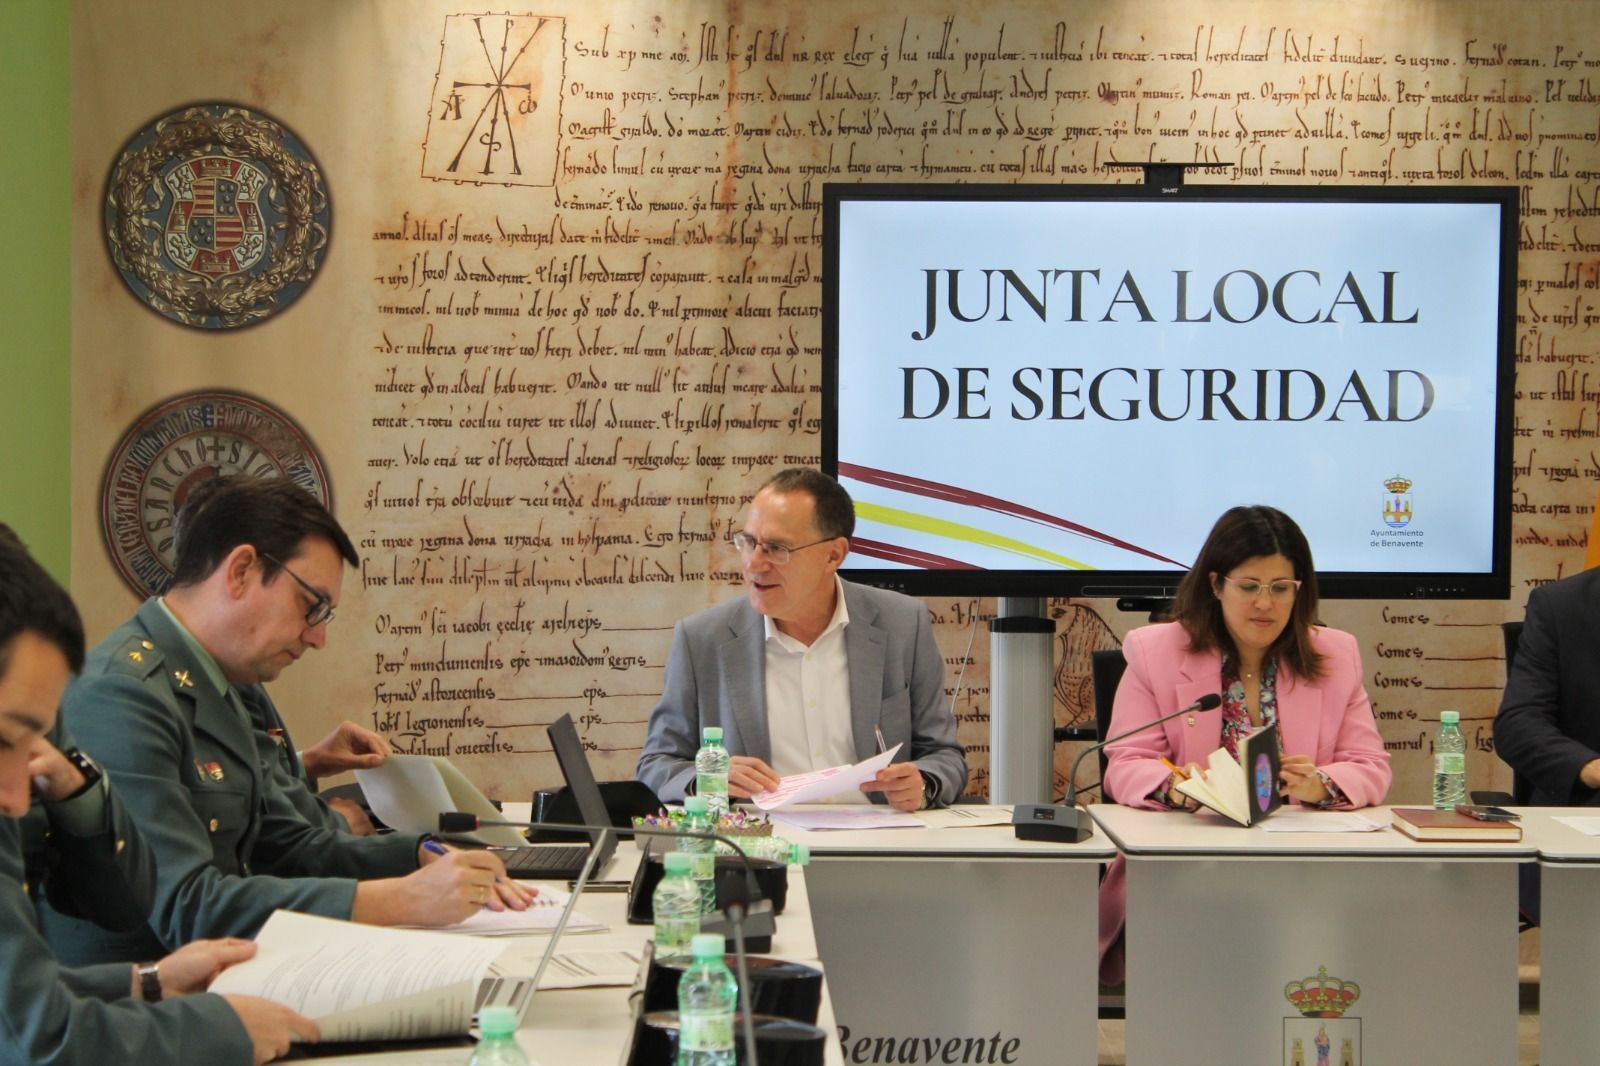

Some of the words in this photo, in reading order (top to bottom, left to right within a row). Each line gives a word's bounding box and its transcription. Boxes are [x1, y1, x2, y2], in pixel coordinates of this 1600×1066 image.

[911, 268, 1157, 341] JUNTA
[1170, 269, 1419, 324] LOCAL
[898, 366, 991, 420] DE
[1010, 366, 1435, 422] SEGURIDAD
[1370, 529, 1425, 537] Ayuntamiento
